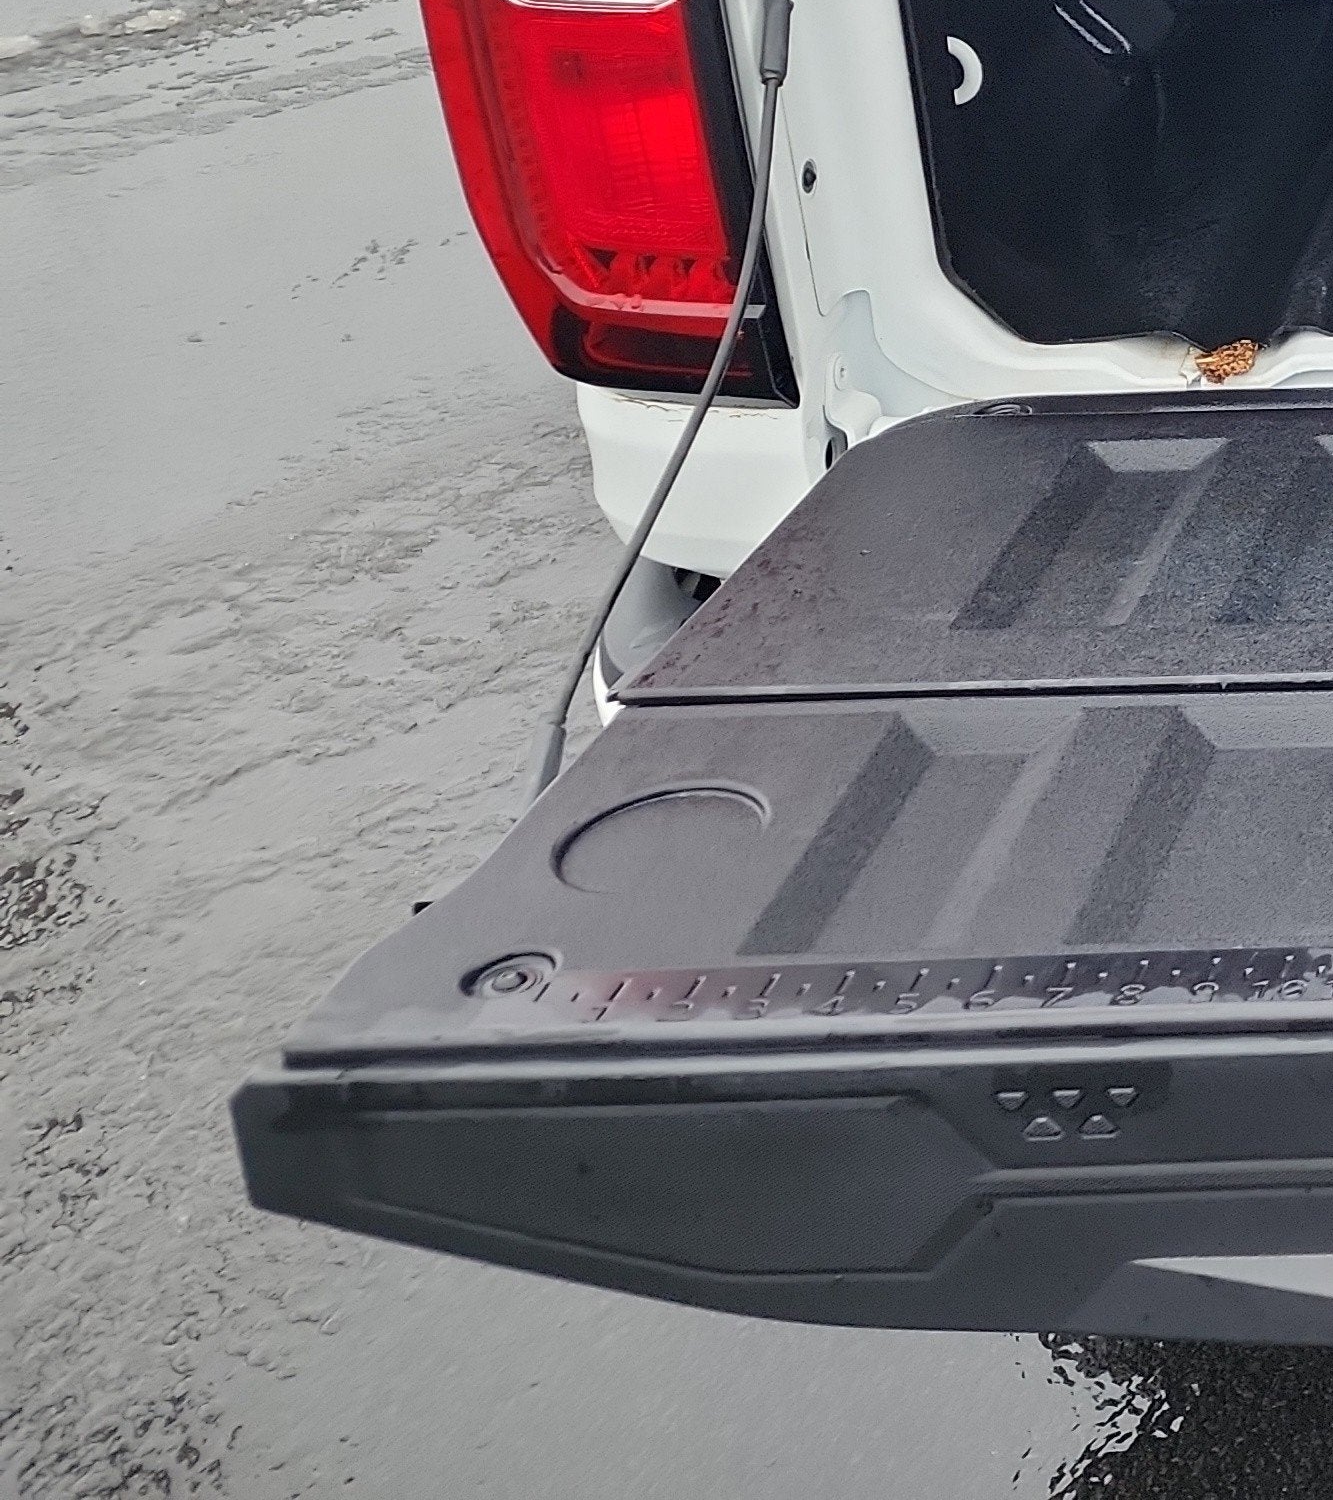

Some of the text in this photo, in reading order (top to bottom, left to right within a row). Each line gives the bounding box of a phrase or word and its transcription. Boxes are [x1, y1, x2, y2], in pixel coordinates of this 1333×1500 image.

[803, 995, 845, 1015] 4
[882, 992, 920, 1014] 5
[964, 990, 996, 1009] 6
[1041, 987, 1074, 1007] 7
[1109, 984, 1146, 1005] 8
[1250, 980, 1309, 1001] 10
